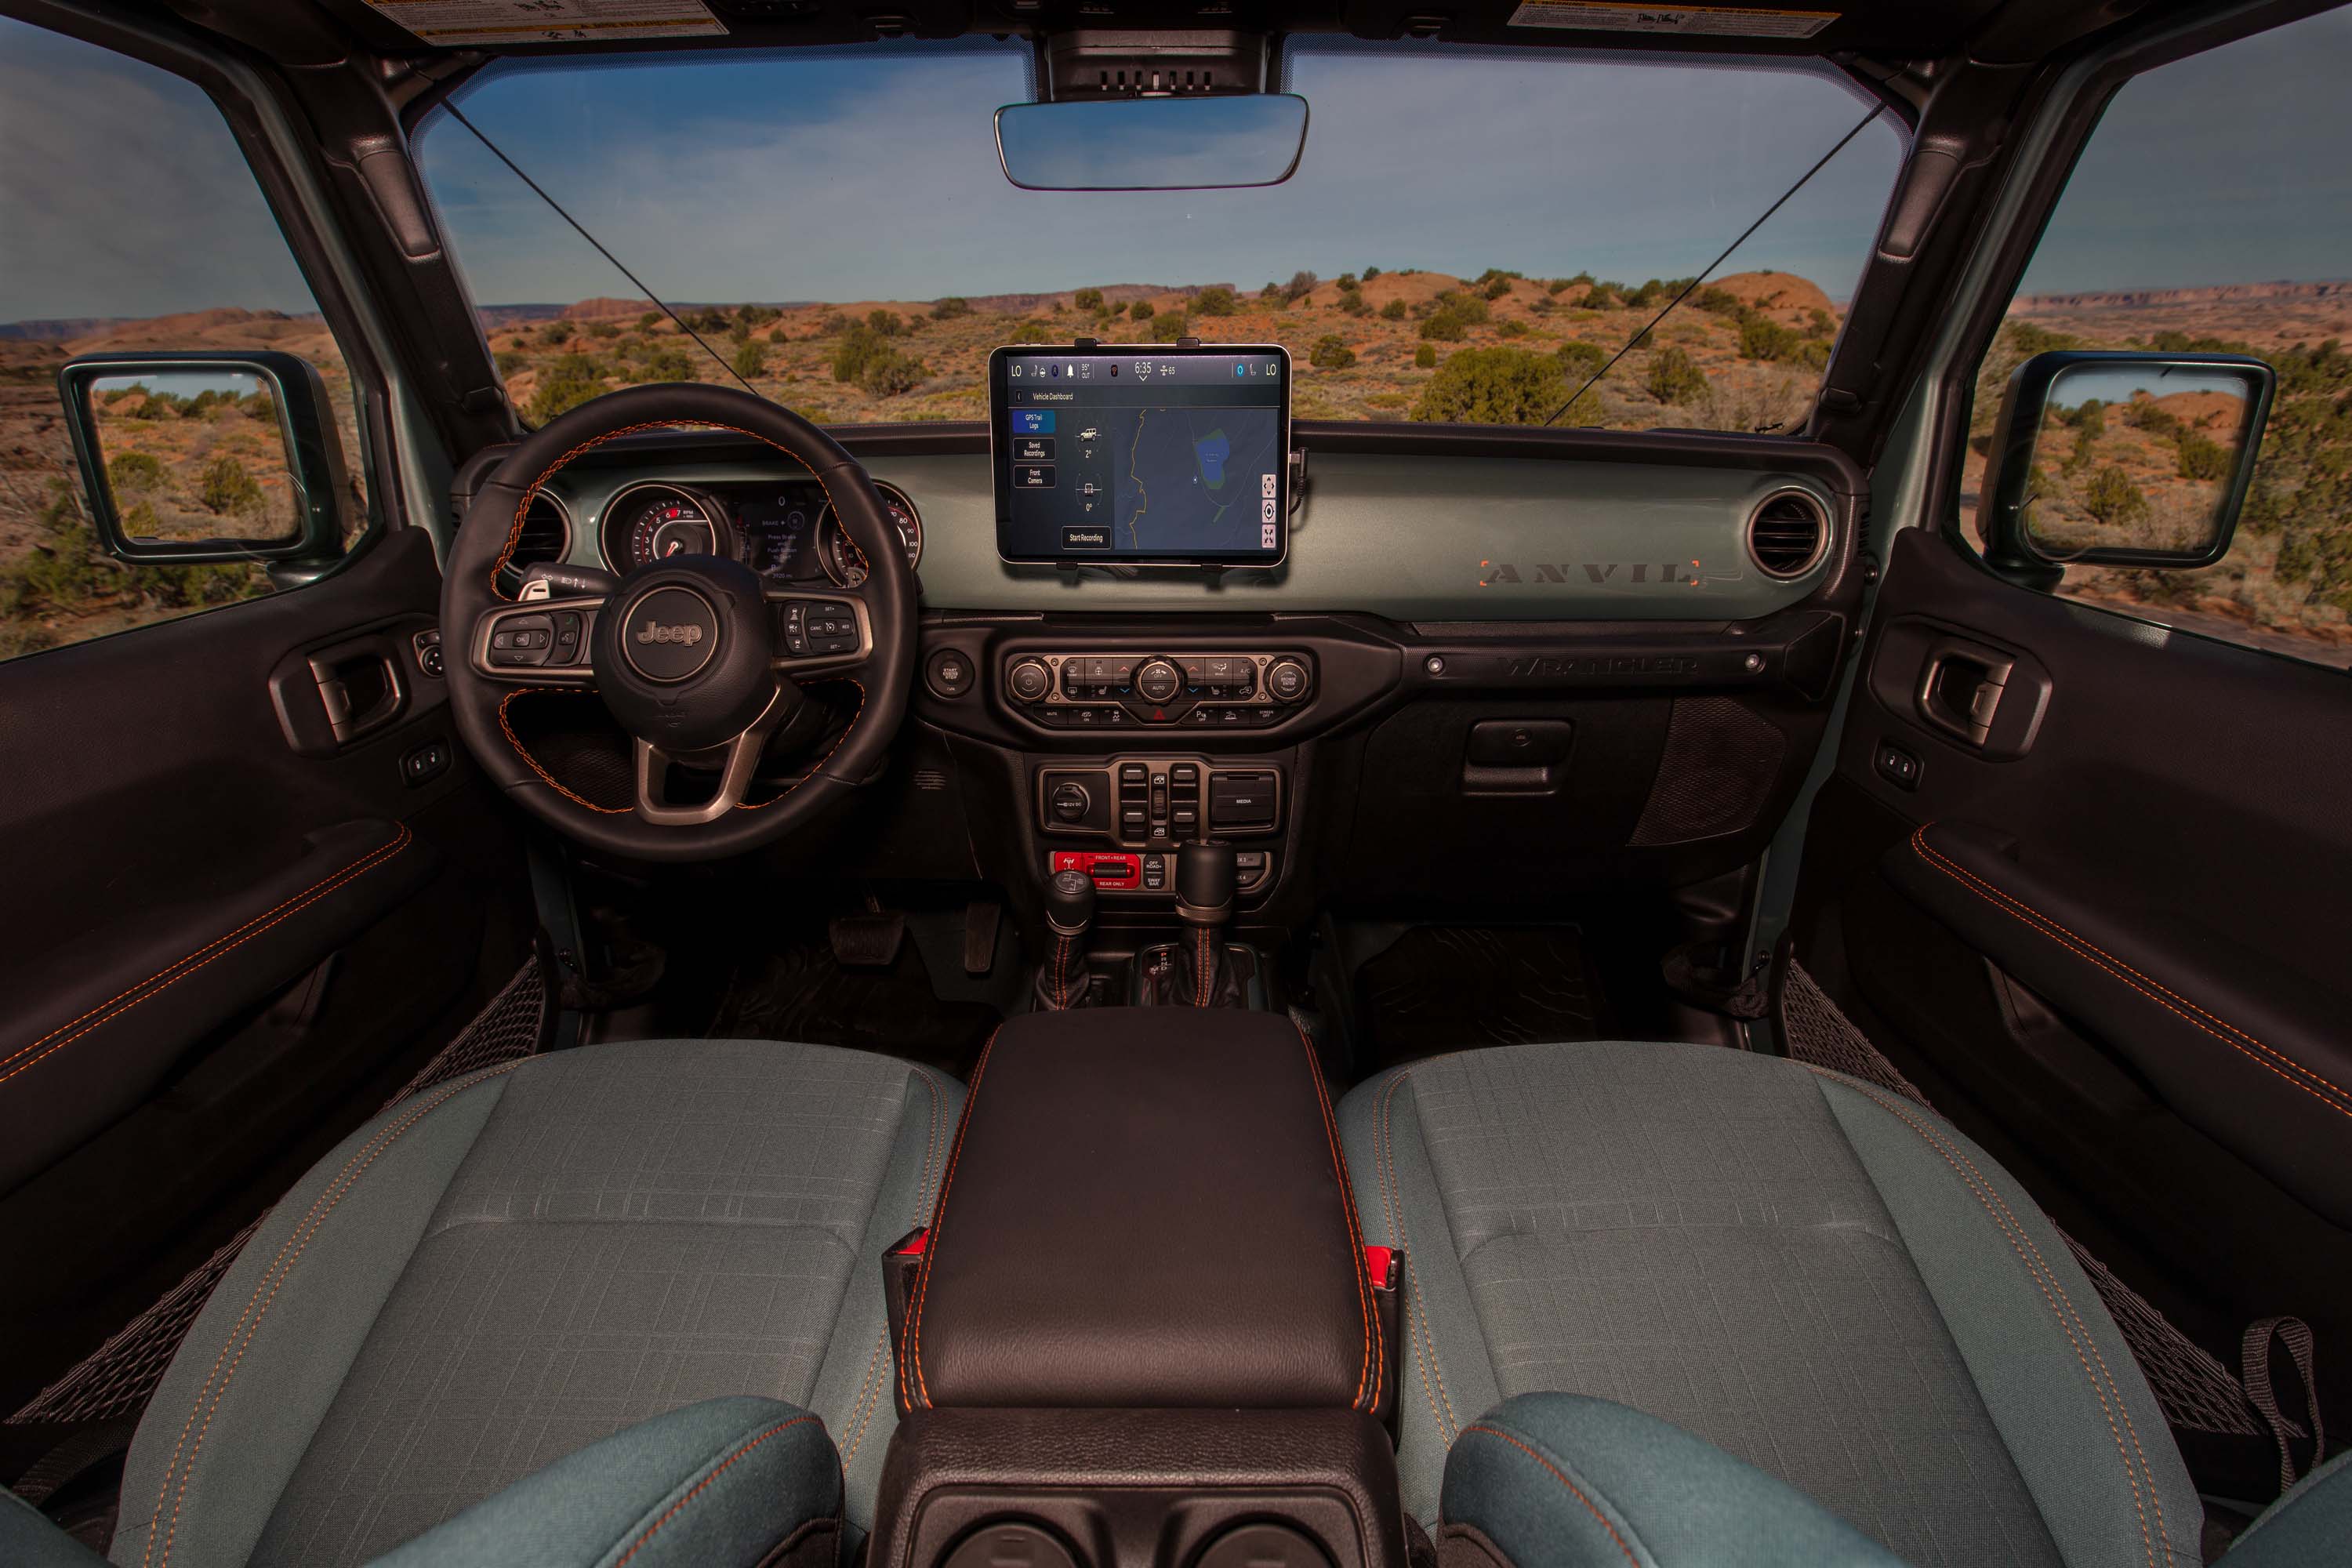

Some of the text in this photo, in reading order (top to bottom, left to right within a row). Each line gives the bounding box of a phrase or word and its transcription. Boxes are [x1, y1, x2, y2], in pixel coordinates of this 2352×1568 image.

[1011, 365, 1022, 376] LO
[1135, 362, 1151, 373] 6:35
[1168, 366, 1175, 375] 65
[1266, 364, 1276, 376] LO
[1081, 534, 1103, 543] Recording
[1486, 564, 1691, 583] ANVIL
[637, 620, 702, 647] Jeep
[1496, 658, 1699, 676] WRANGLER
